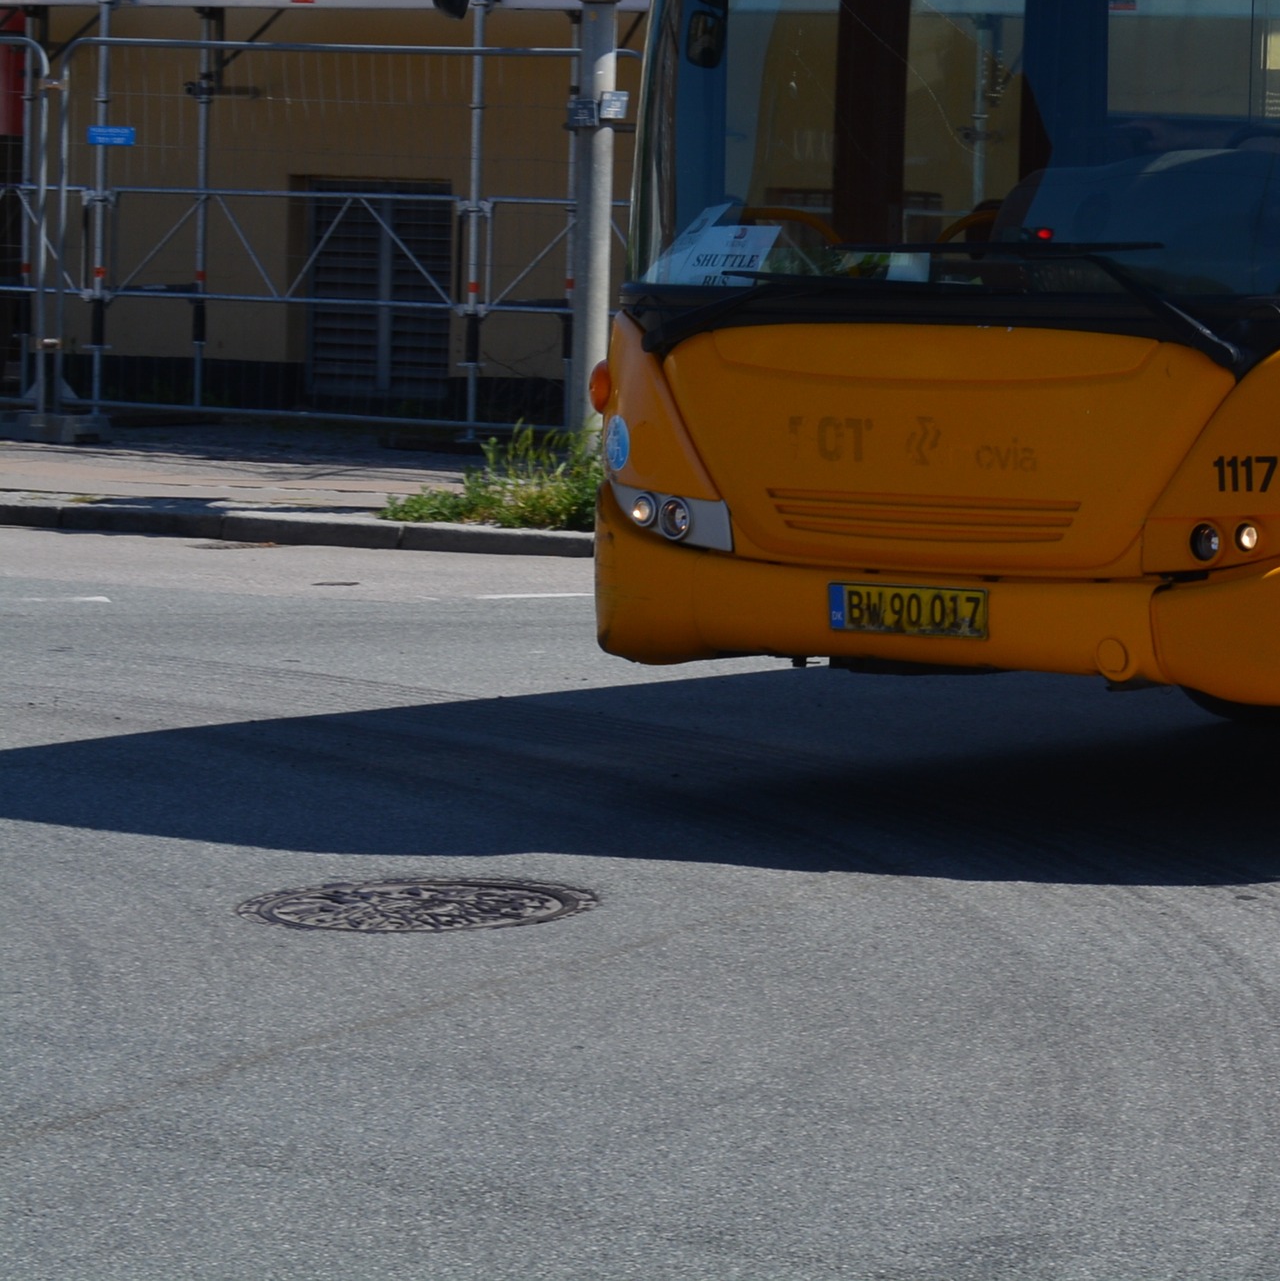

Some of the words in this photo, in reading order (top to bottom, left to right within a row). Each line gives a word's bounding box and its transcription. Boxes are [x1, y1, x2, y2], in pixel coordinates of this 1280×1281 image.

[692, 253, 760, 268] SHUTTLE
[1213, 456, 1278, 493] 1117
[890, 593, 922, 627] 90
[931, 594, 981, 628] 017
